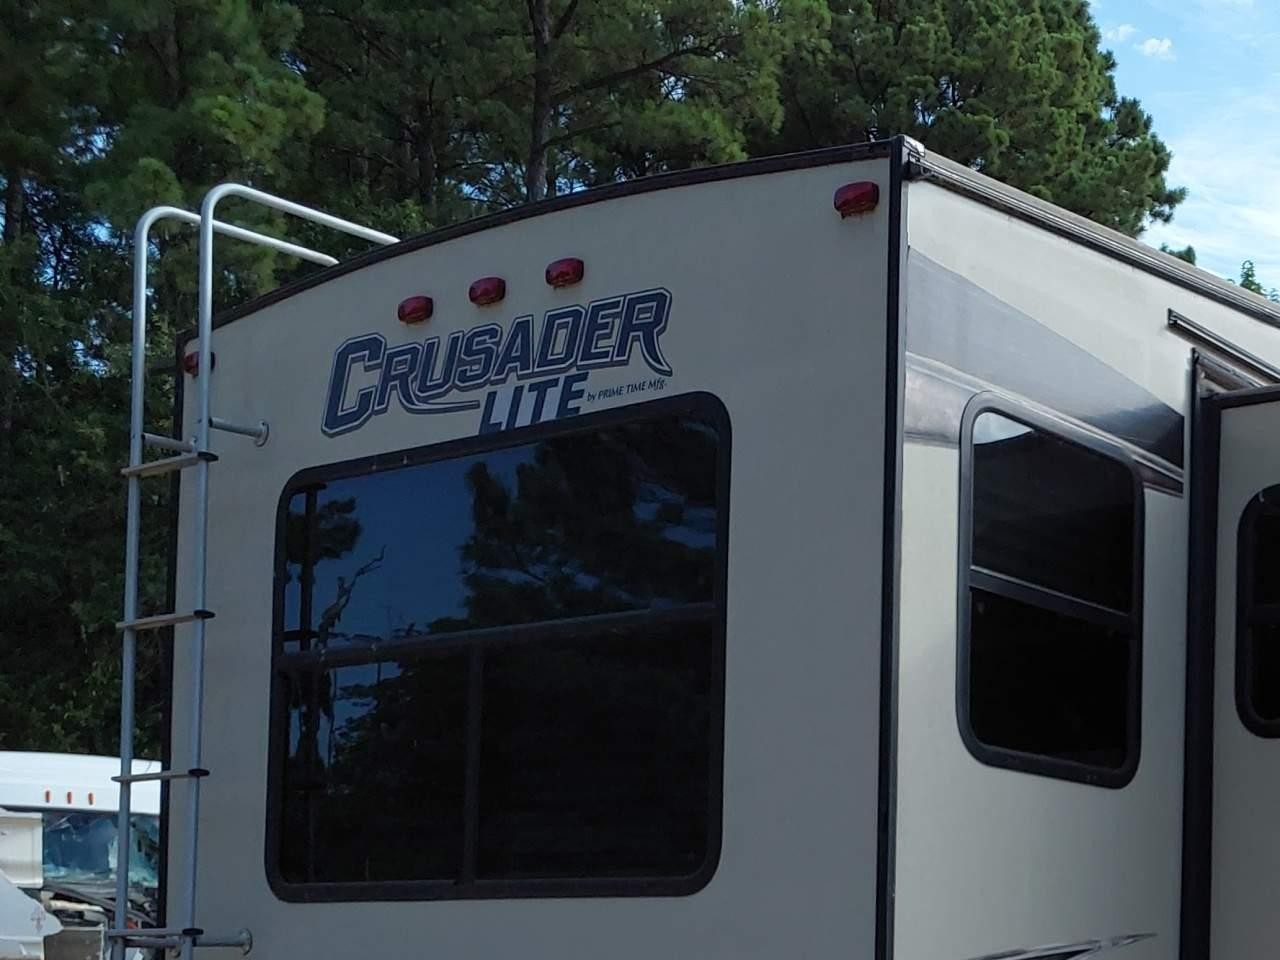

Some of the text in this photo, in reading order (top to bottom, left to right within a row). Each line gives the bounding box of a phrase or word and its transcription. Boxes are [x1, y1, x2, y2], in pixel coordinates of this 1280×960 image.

[321, 287, 673, 438] CRUSADER
[587, 391, 597, 402] by
[597, 386, 625, 400] PRIME
[626, 380, 646, 394] TIME
[478, 371, 589, 435] LITE
